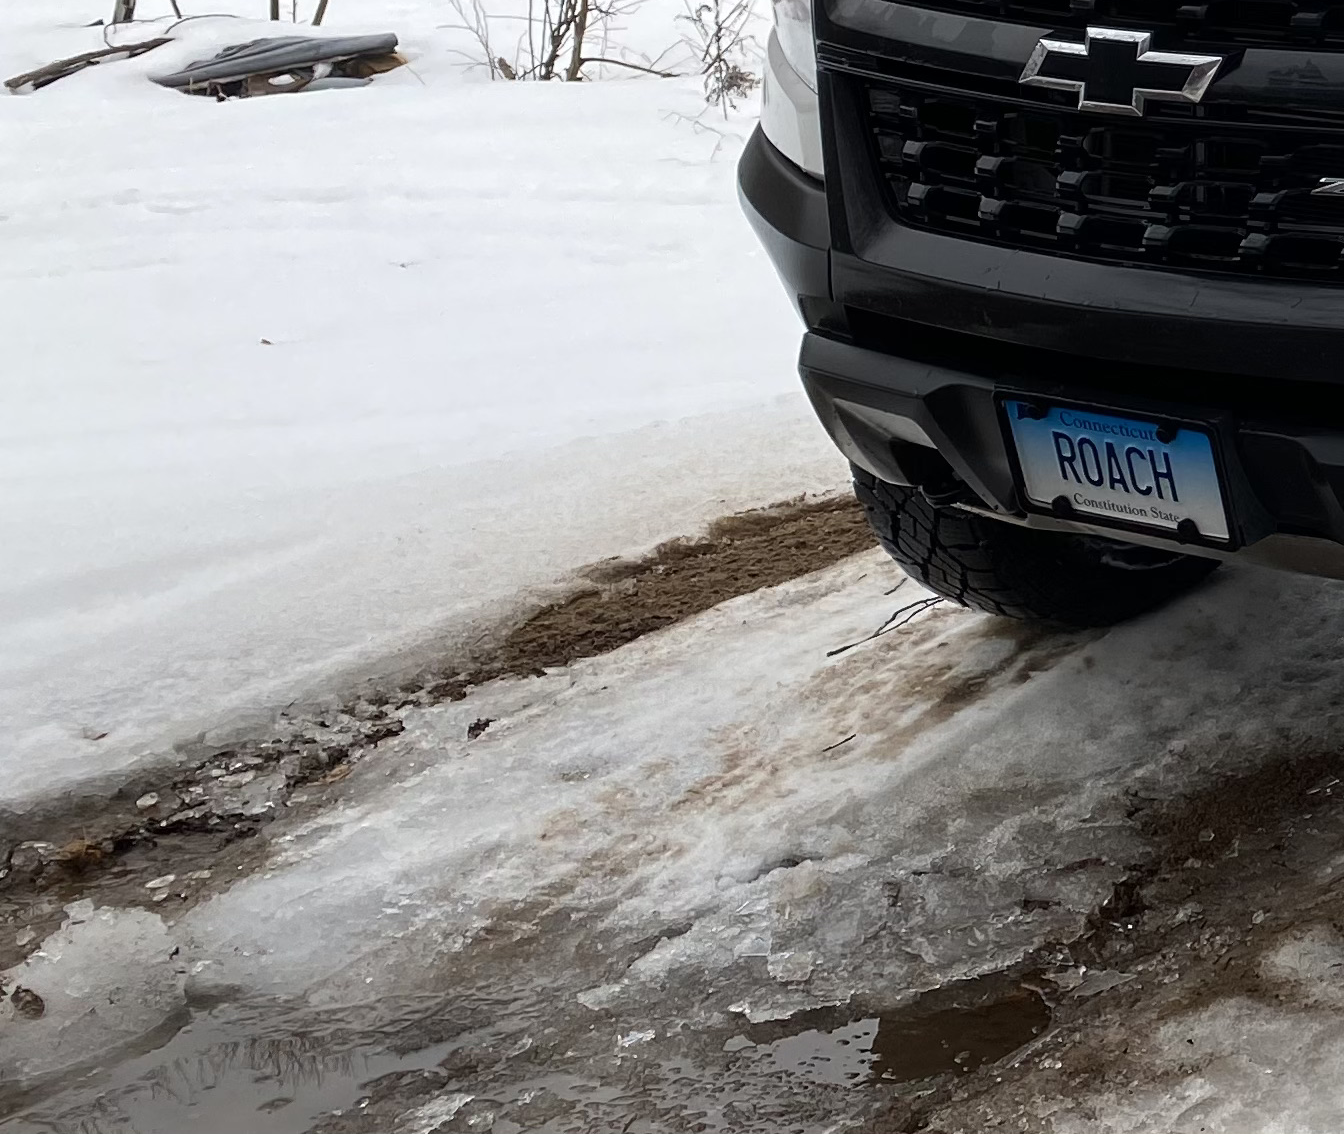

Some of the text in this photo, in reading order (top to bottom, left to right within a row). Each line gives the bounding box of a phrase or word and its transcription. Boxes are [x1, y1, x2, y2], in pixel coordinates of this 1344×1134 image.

[1059, 412, 1156, 442] Connecticut
[1052, 431, 1179, 502] ROACH
[1073, 492, 1181, 523] Constitution State
